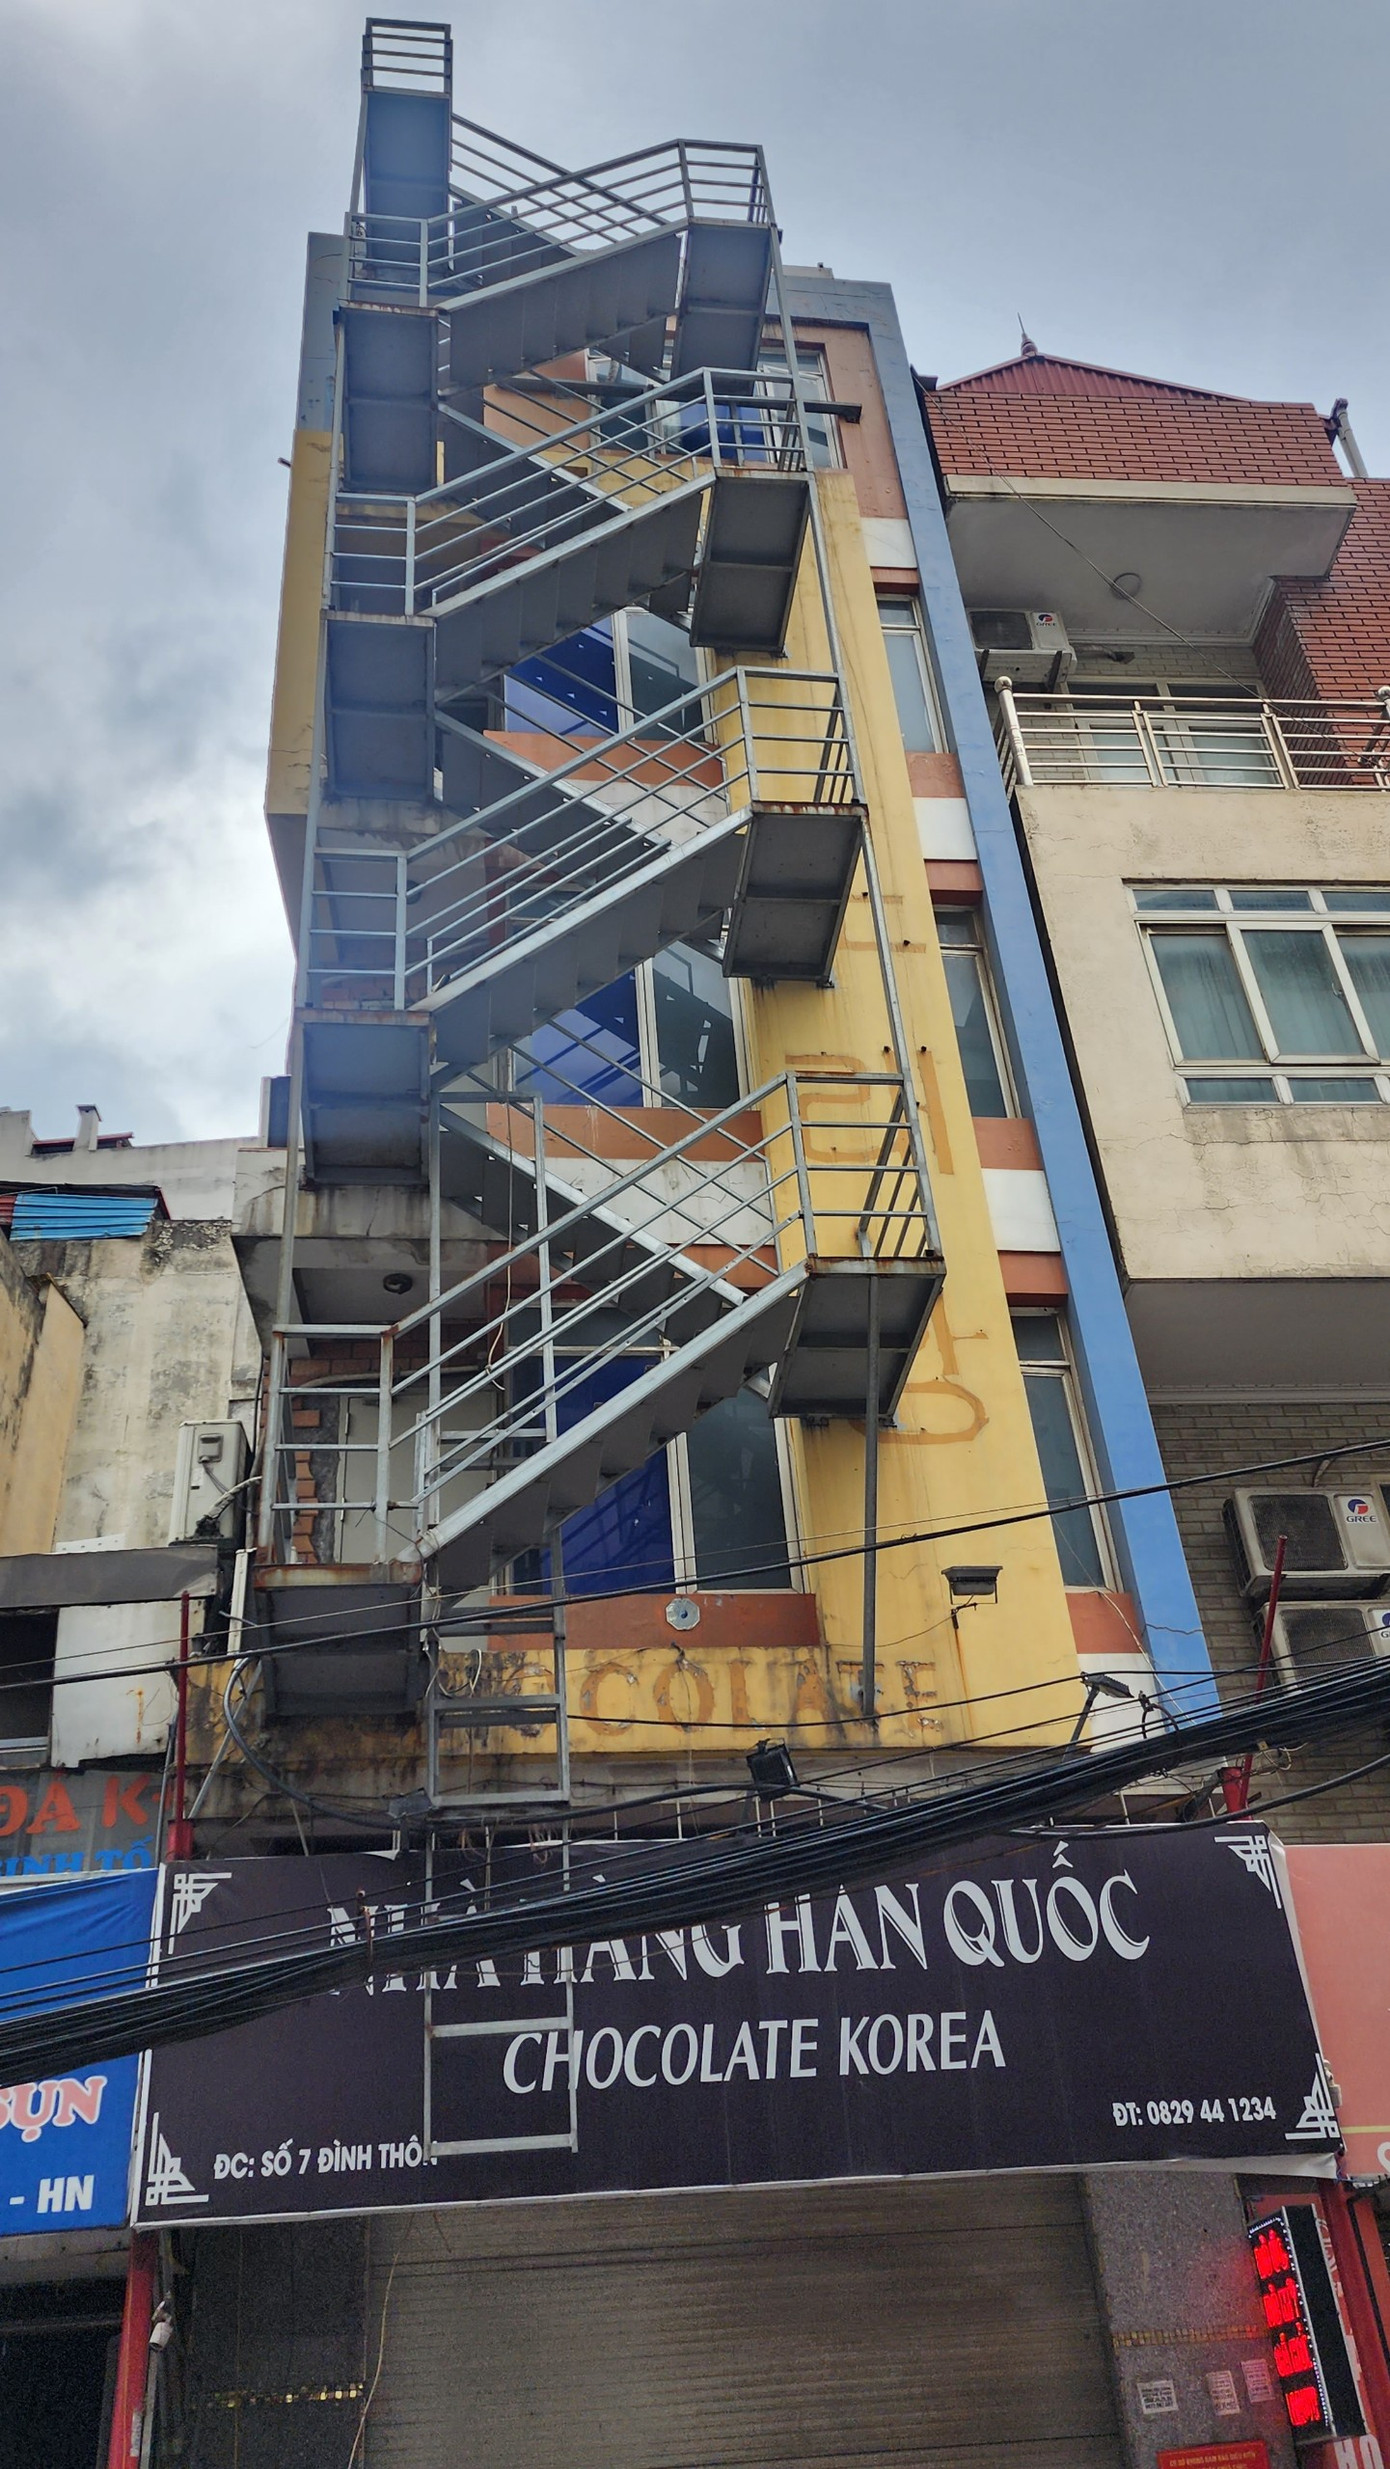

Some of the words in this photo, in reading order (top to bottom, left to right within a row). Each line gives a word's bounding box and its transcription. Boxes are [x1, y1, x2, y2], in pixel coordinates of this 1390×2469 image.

[1345, 1515, 1377, 1523] GREE
[944, 1840, 1150, 1967] QUỐC
[502, 2018, 819, 2094] CHOCOLATE
[839, 2009, 1006, 2075] KOREA
[1112, 2102, 1143, 2126] ĐT:
[1146, 2100, 1194, 2125] 0829
[1200, 2099, 1225, 2123] 44
[1228, 2096, 1277, 2122] 1234
[213, 2153, 254, 2180] ĐC:
[261, 2138, 294, 2178] SỐ
[298, 2148, 311, 2175] 7
[317, 2139, 372, 2174] ĐÌNH
[36, 2174, 95, 2214] HN
